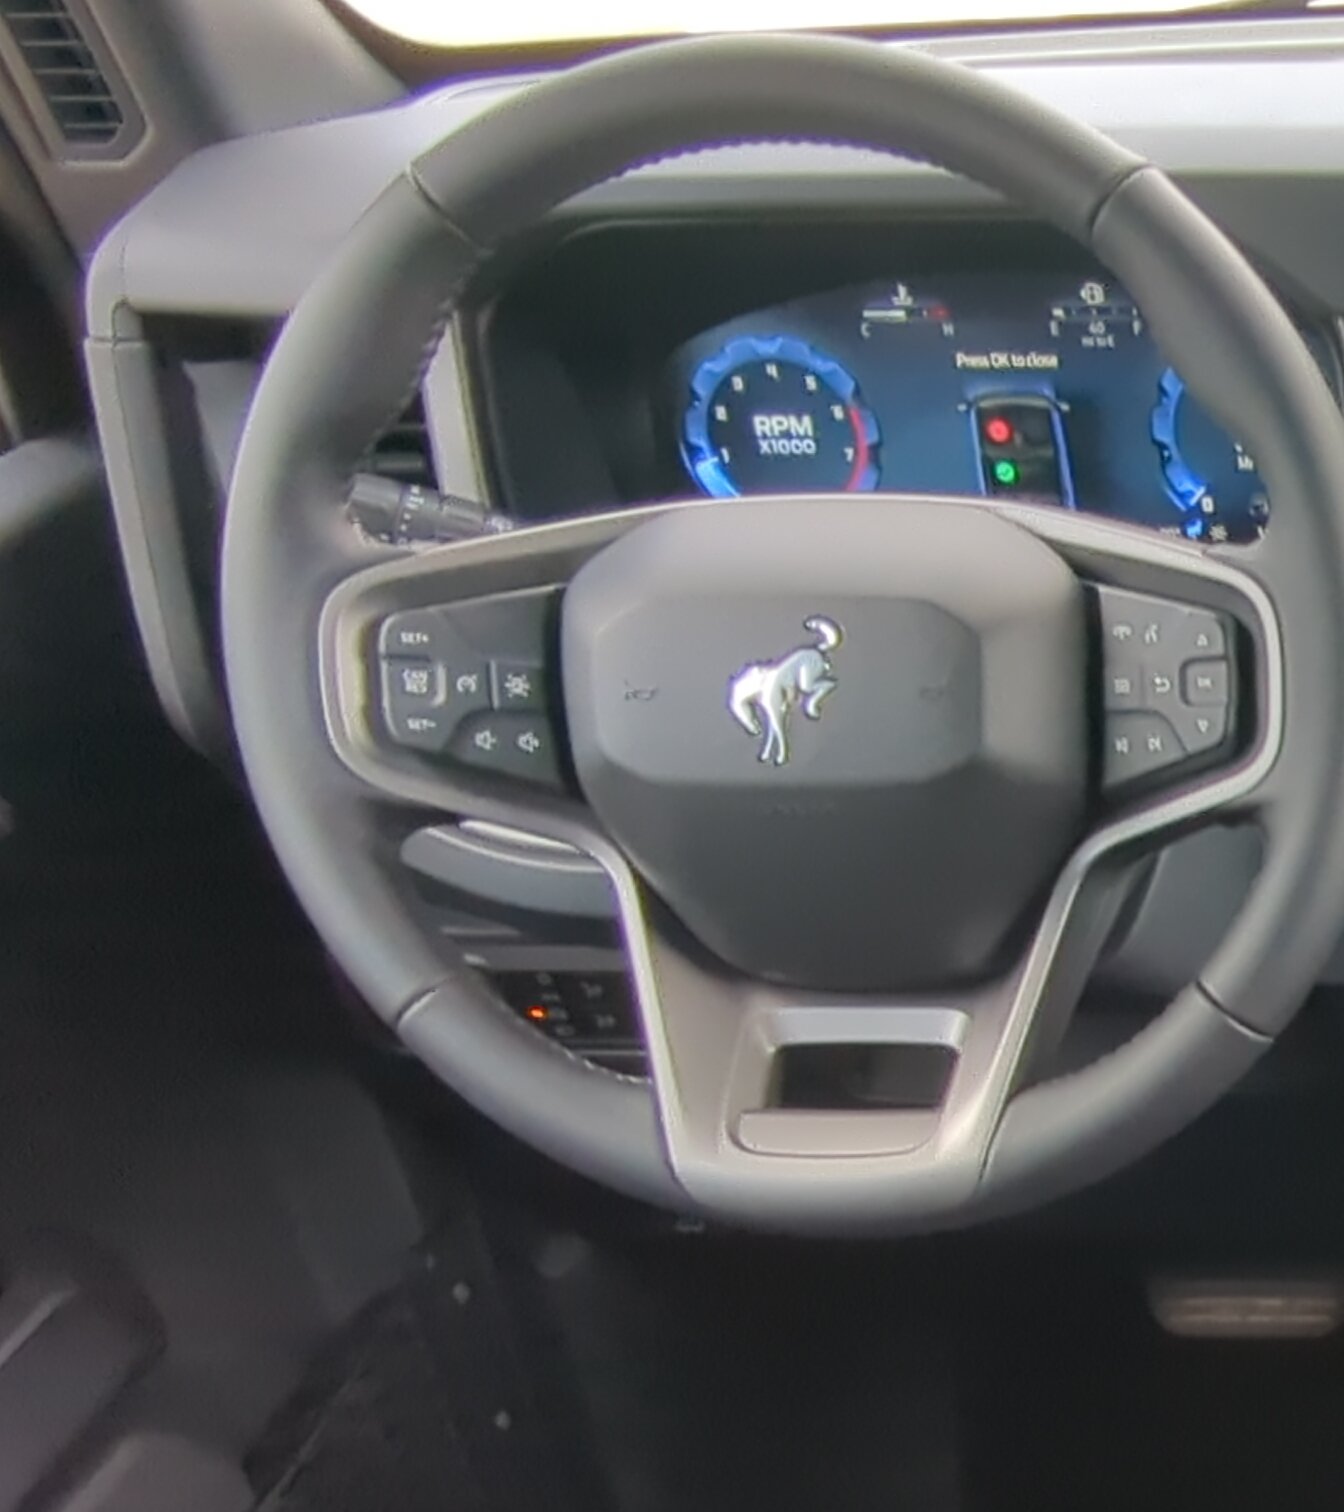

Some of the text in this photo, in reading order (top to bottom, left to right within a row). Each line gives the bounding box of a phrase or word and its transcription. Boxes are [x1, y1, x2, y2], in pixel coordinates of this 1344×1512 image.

[956, 351, 990, 369] Press
[990, 351, 1011, 369] OK
[1026, 352, 1058, 370] close
[764, 362, 780, 382] 4
[752, 413, 814, 438] RPM
[757, 437, 817, 455] X1000
